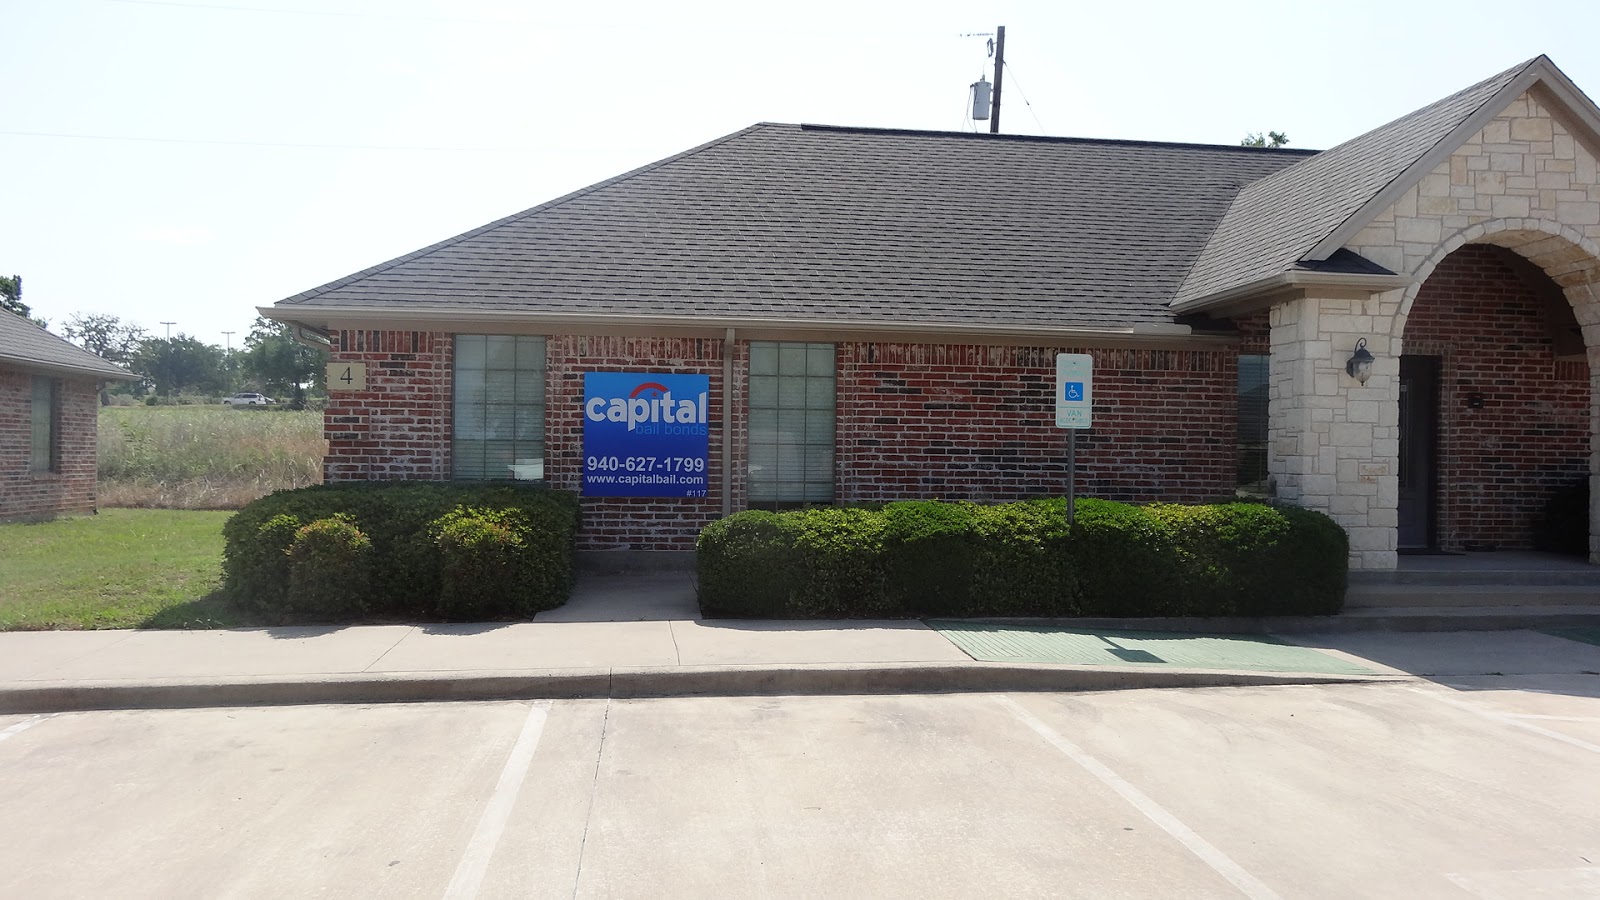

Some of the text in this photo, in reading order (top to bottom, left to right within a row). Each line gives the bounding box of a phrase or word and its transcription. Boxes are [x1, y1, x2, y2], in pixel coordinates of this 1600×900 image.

[340, 366, 353, 384] 4
[586, 391, 707, 432] capital
[635, 423, 707, 436] bail bonds
[587, 456, 704, 472] 940-627-1799
[587, 474, 704, 486] www.capitalbail.com
[686, 489, 707, 497] #117
